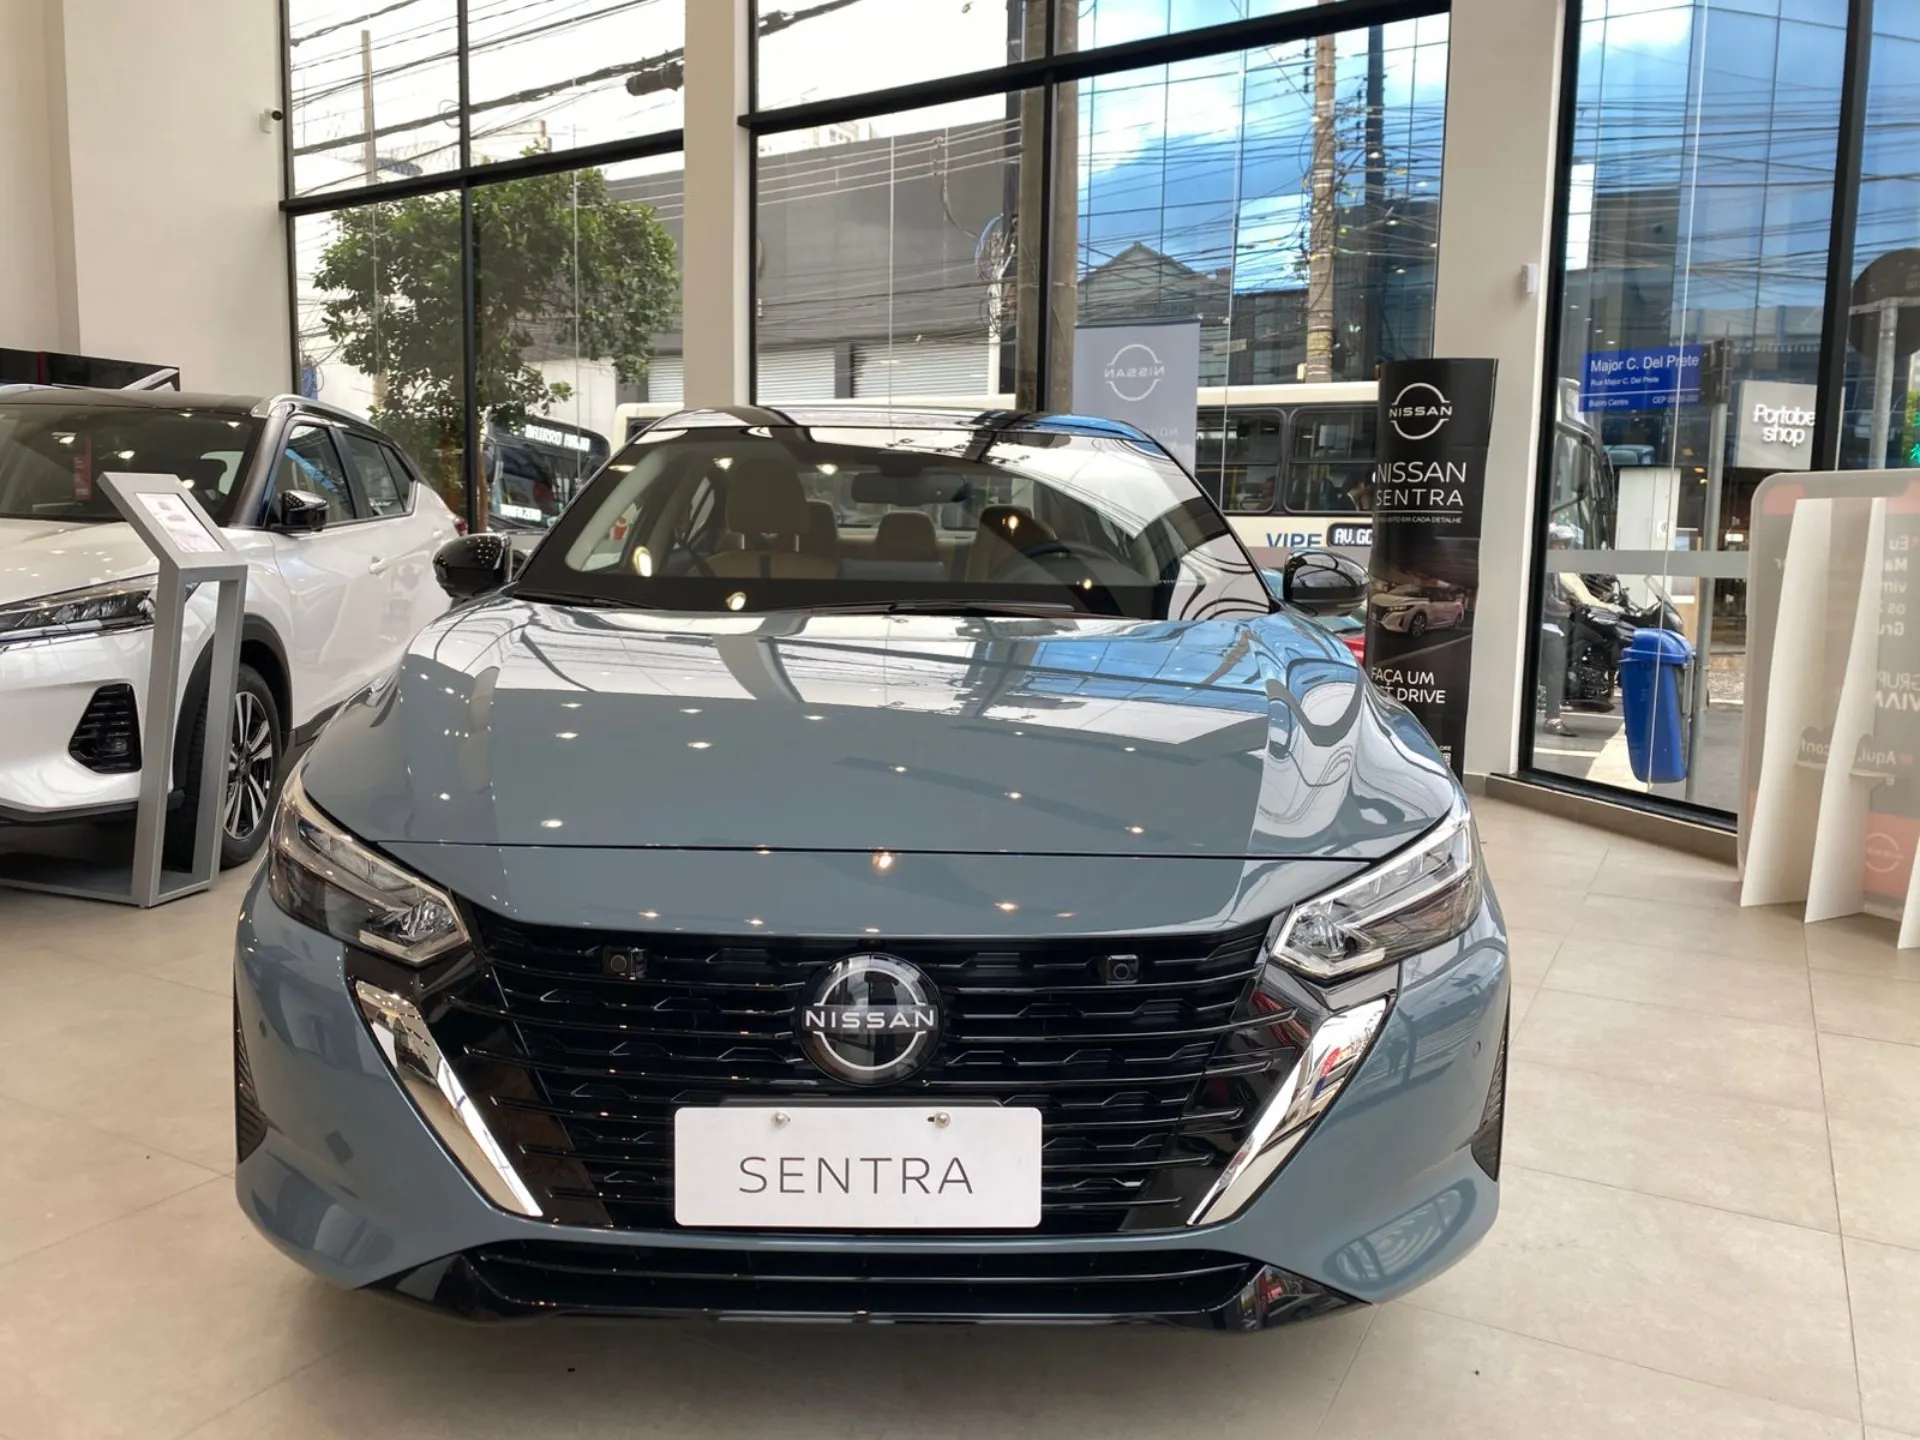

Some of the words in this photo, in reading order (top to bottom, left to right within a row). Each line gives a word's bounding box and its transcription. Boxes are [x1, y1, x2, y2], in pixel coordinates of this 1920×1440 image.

[1590, 359, 1624, 375] Major
[1626, 357, 1640, 370] C.
[1643, 355, 1663, 370] Del
[1666, 354, 1699, 368] Prete
[1388, 405, 1453, 418] NISSAN
[1763, 425, 1806, 447] shop
[1377, 461, 1467, 484] NISSAN
[1376, 489, 1464, 507] SENTRA
[1371, 667, 1404, 686] FAÇA
[1407, 670, 1435, 686] UM
[1397, 688, 1446, 704] DRIVE
[805, 1009, 934, 1029] NISSAN
[738, 1156, 973, 1195] SENTRA
